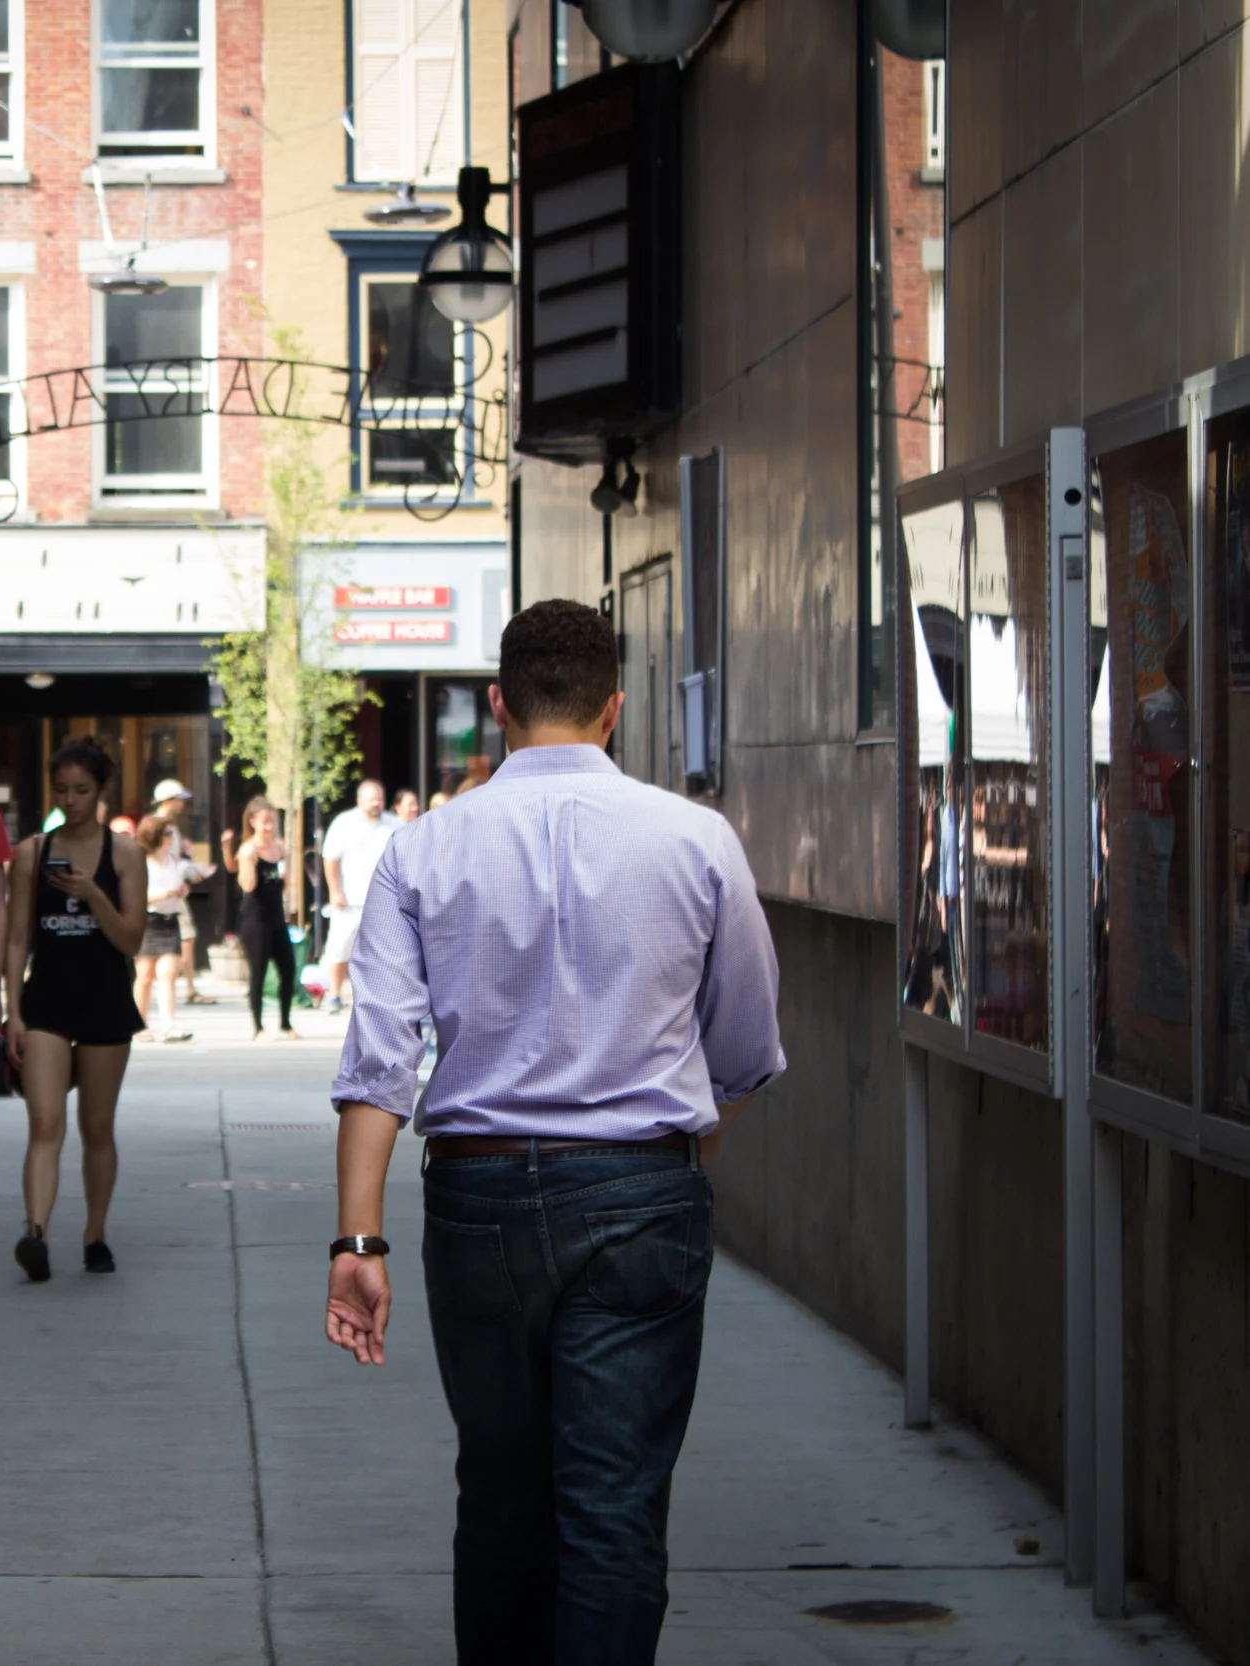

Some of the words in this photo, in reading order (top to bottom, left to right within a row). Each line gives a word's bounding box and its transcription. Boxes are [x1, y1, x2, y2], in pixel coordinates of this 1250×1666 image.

[404, 588, 435, 605] BAR
[394, 622, 445, 640] HOUSE
[41, 915, 98, 930] CORNEL
